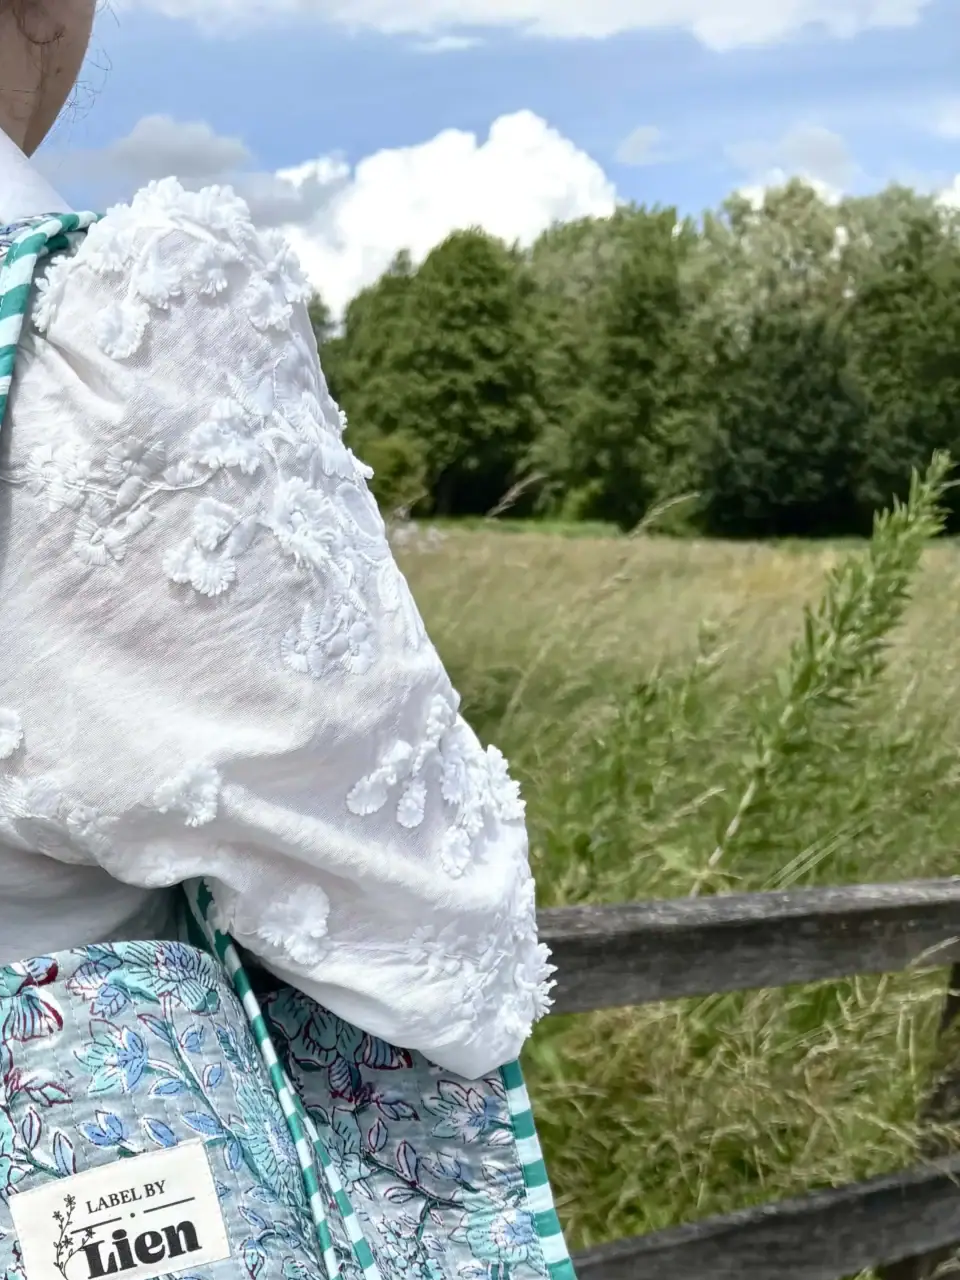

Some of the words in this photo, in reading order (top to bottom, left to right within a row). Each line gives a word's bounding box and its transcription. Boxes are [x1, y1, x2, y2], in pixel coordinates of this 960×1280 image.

[85, 1187, 142, 1214] LABEL
[143, 1179, 167, 1198] BY
[83, 1220, 203, 1280] Lien
